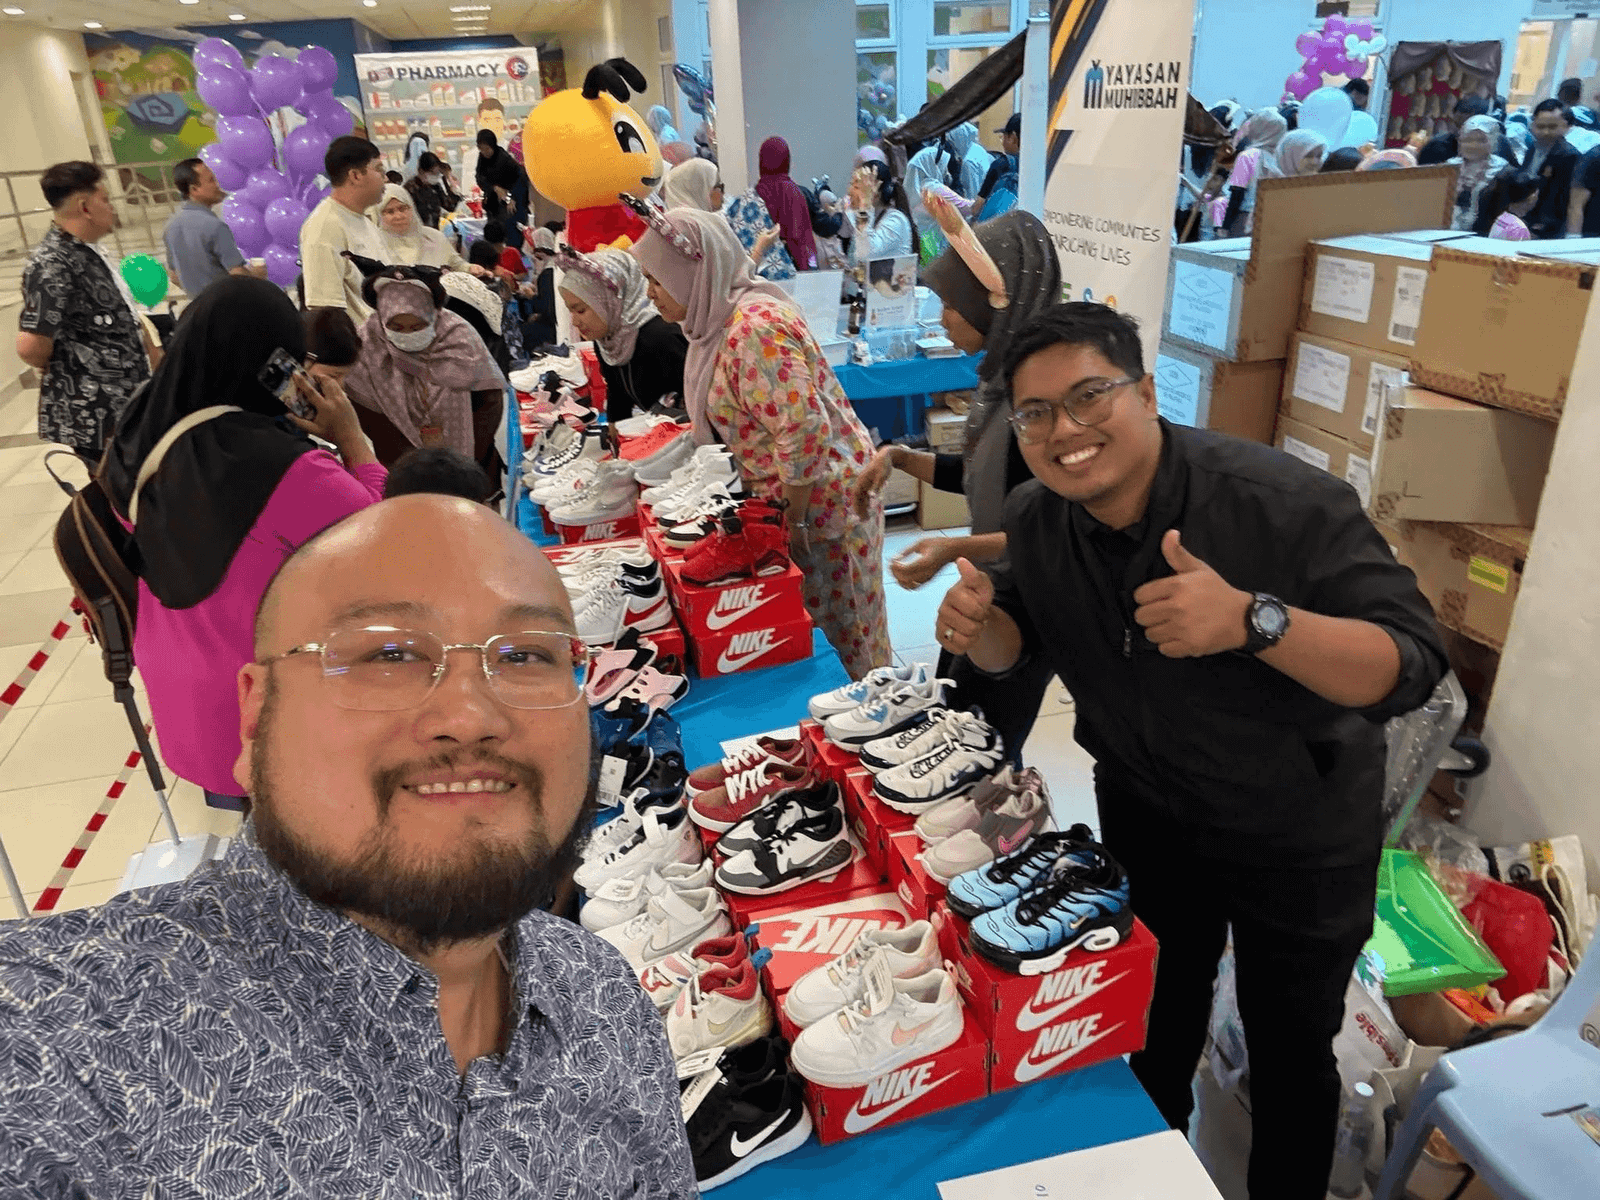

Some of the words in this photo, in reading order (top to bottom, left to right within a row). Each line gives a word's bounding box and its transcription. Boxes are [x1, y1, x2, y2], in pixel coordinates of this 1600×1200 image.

[397, 63, 500, 81] PHARMACY
[1105, 61, 1181, 86] YAYASAN
[1103, 87, 1178, 109] MUHIBBAH
[583, 521, 619, 541] NIKE
[716, 583, 766, 613] NIKE
[727, 627, 777, 657] NIKE
[1031, 959, 1109, 1007] NIKE
[1029, 1012, 1104, 1059] NIKE
[860, 1060, 937, 1110] NIKE
